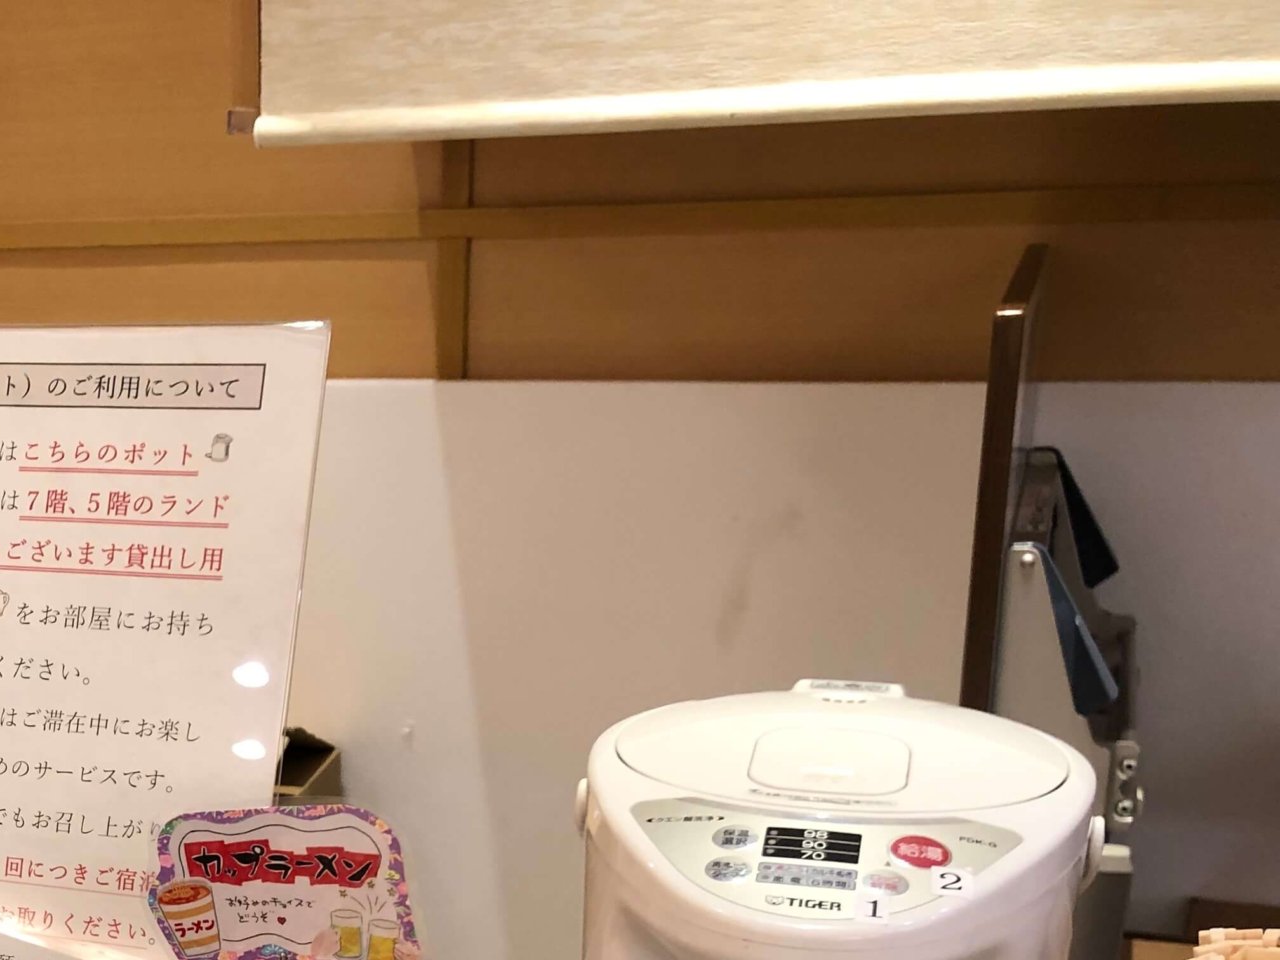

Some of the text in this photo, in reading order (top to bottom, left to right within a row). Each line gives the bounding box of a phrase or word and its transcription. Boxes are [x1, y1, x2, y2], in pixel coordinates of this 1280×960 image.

[16, 603, 216, 637] をお部屋にお持ち
[803, 829, 828, 839] 98
[801, 839, 826, 849] 90
[192, 845, 373, 882] カップラーメン
[800, 850, 825, 860] 70
[940, 872, 962, 891] 2
[786, 897, 842, 911] TIGER
[865, 899, 883, 918] 1
[174, 919, 216, 938] ラーメン
